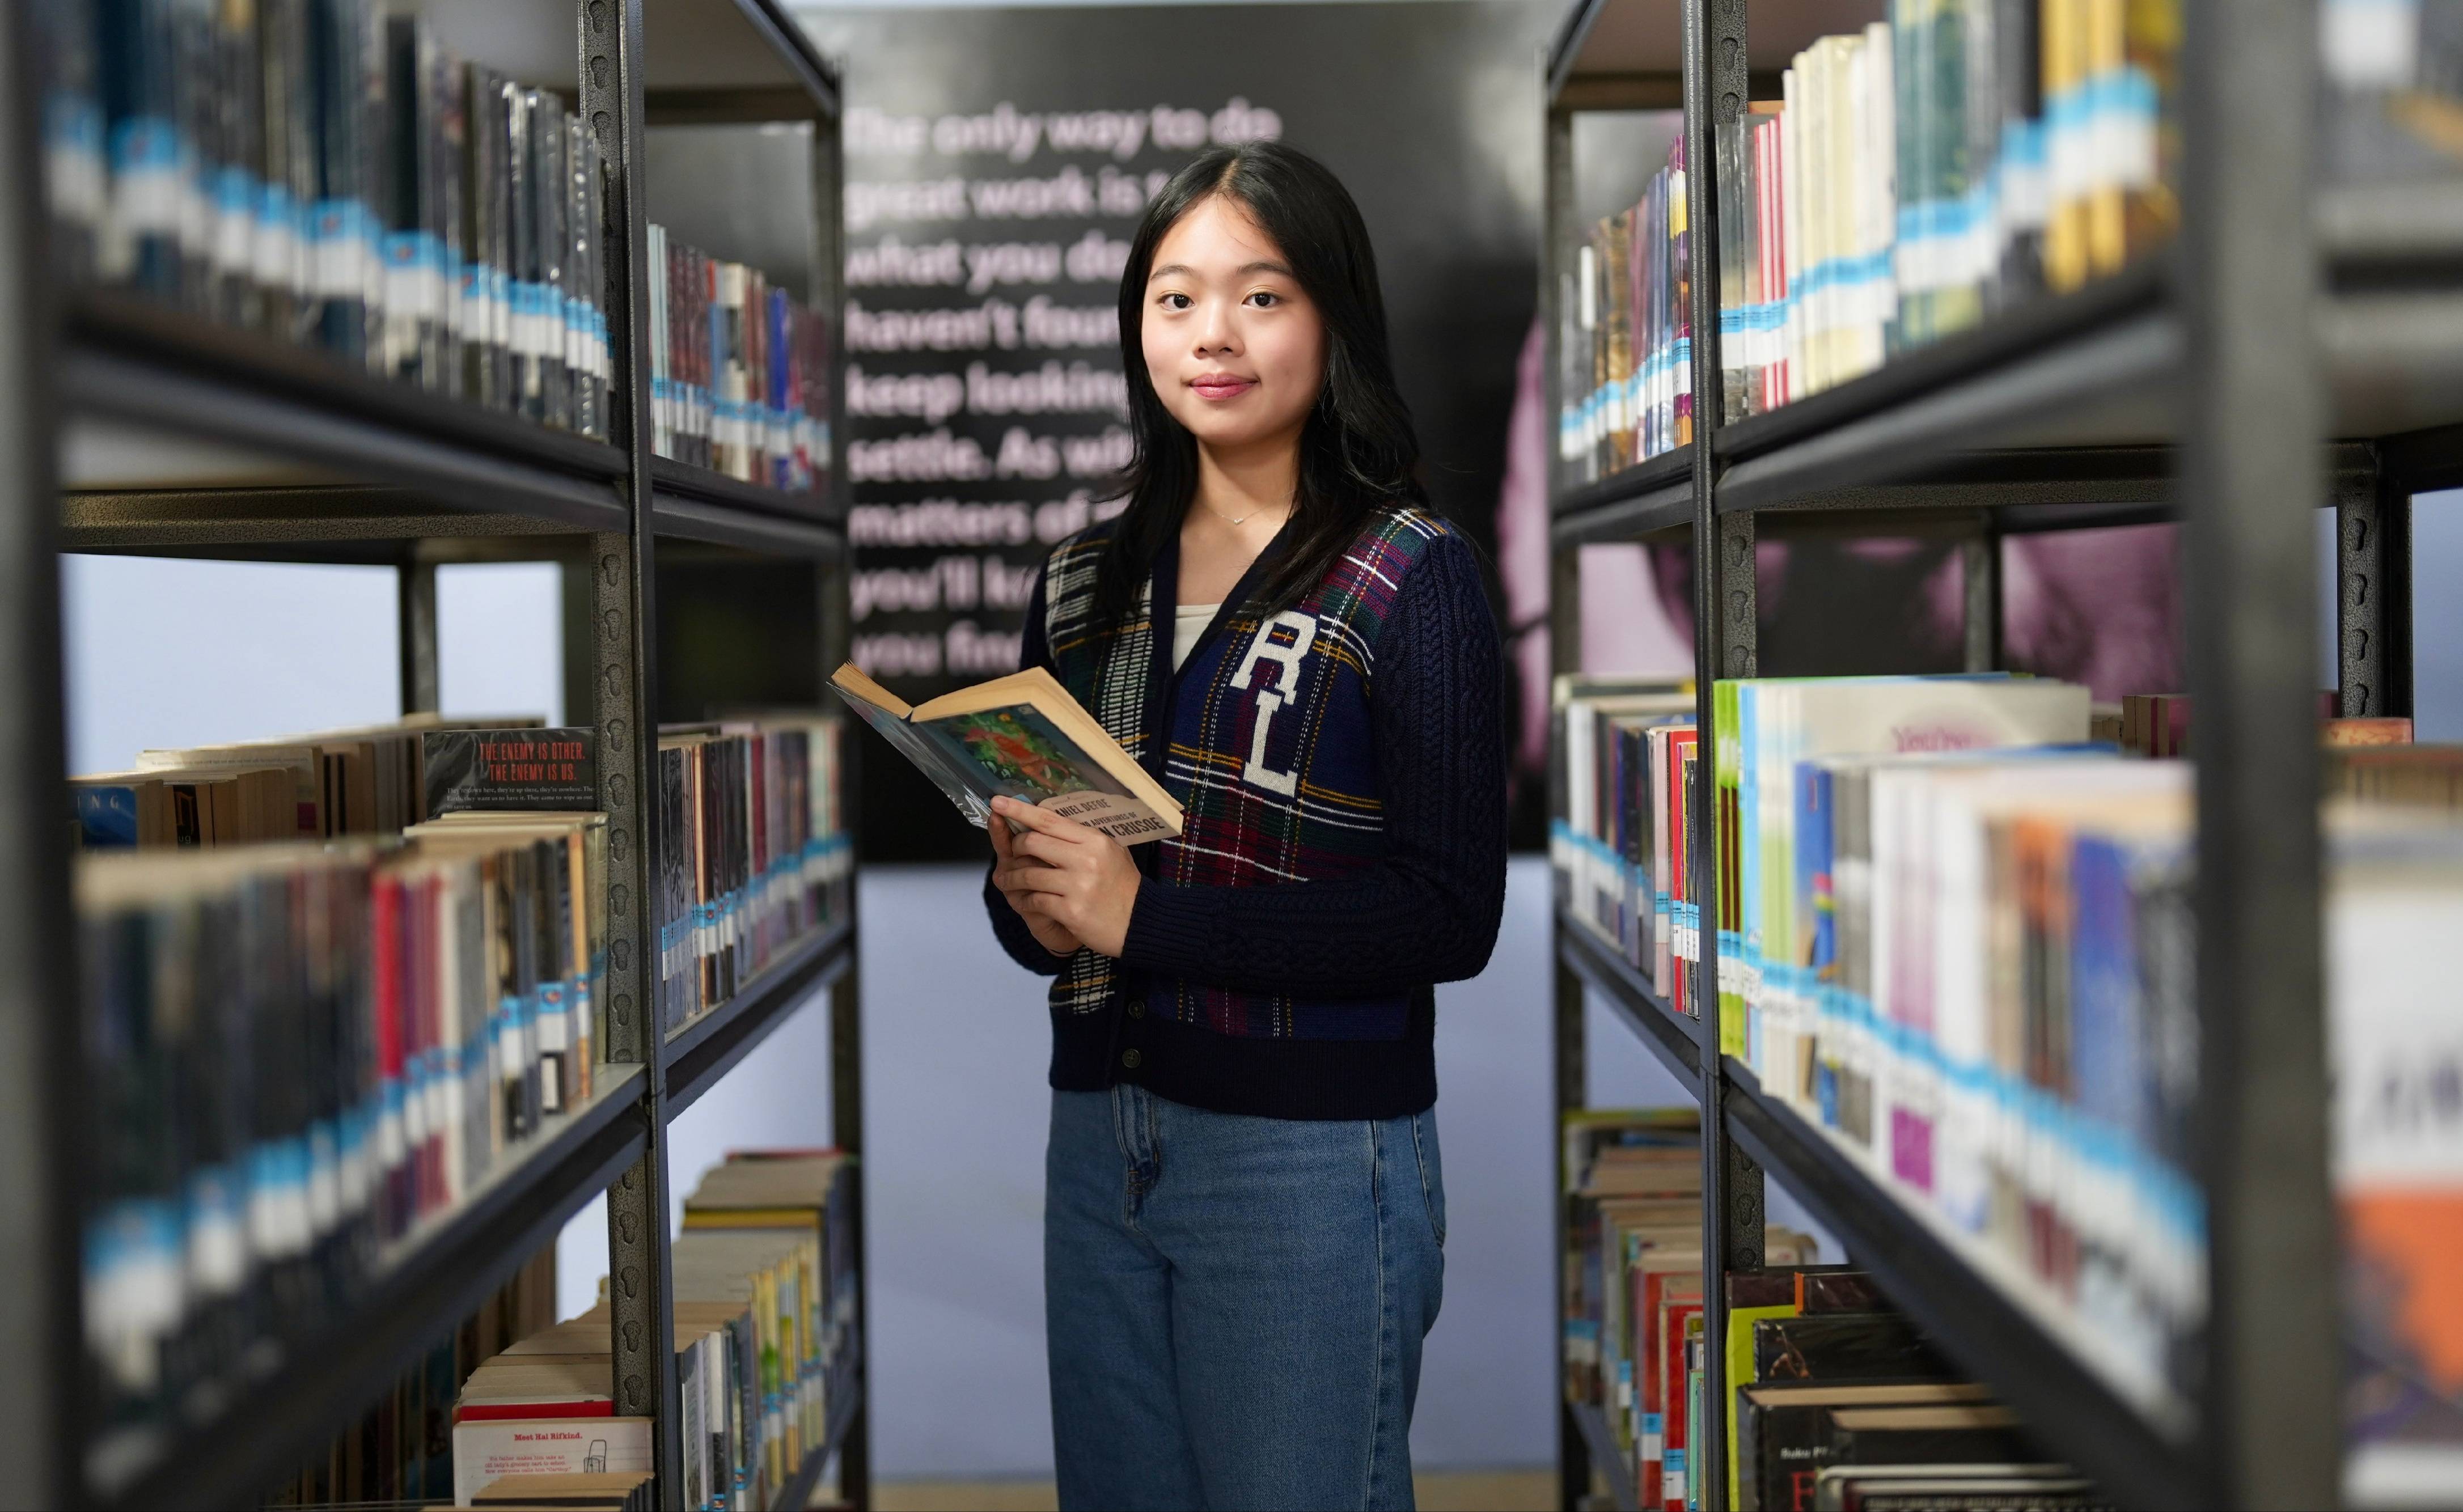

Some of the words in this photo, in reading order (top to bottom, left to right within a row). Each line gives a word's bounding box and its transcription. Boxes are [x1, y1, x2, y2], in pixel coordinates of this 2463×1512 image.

[931, 102, 1042, 160] only
[1047, 115, 1148, 159] way
[1152, 104, 1209, 149] to
[1211, 98, 1284, 147] do
[971, 164, 1094, 219] work
[1098, 164, 1145, 217] is
[845, 235, 962, 287] what
[965, 244, 1061, 295] you
[845, 299, 1019, 351] haven't
[1023, 296, 1121, 350] foun
[845, 364, 965, 423] keep
[996, 425, 1061, 480] As
[847, 497, 1032, 547] matters
[1230, 611, 1317, 705] R
[480, 743, 497, 760] THE
[501, 743, 535, 760] ENEMY
[538, 743, 547, 760] IS
[552, 742, 585, 760] OTHER.
[1243, 689, 1298, 797] L
[490, 764, 507, 781] THE
[511, 764, 543, 781] ENEMY
[548, 764, 557, 780] IS
[561, 763, 577, 780] US.
[1054, 805, 1083, 818] ANIEL
[1080, 799, 1111, 812] DEFOE
[1091, 813, 1128, 827] ADVENTURES
[1111, 818, 1165, 837] CRUSOE
